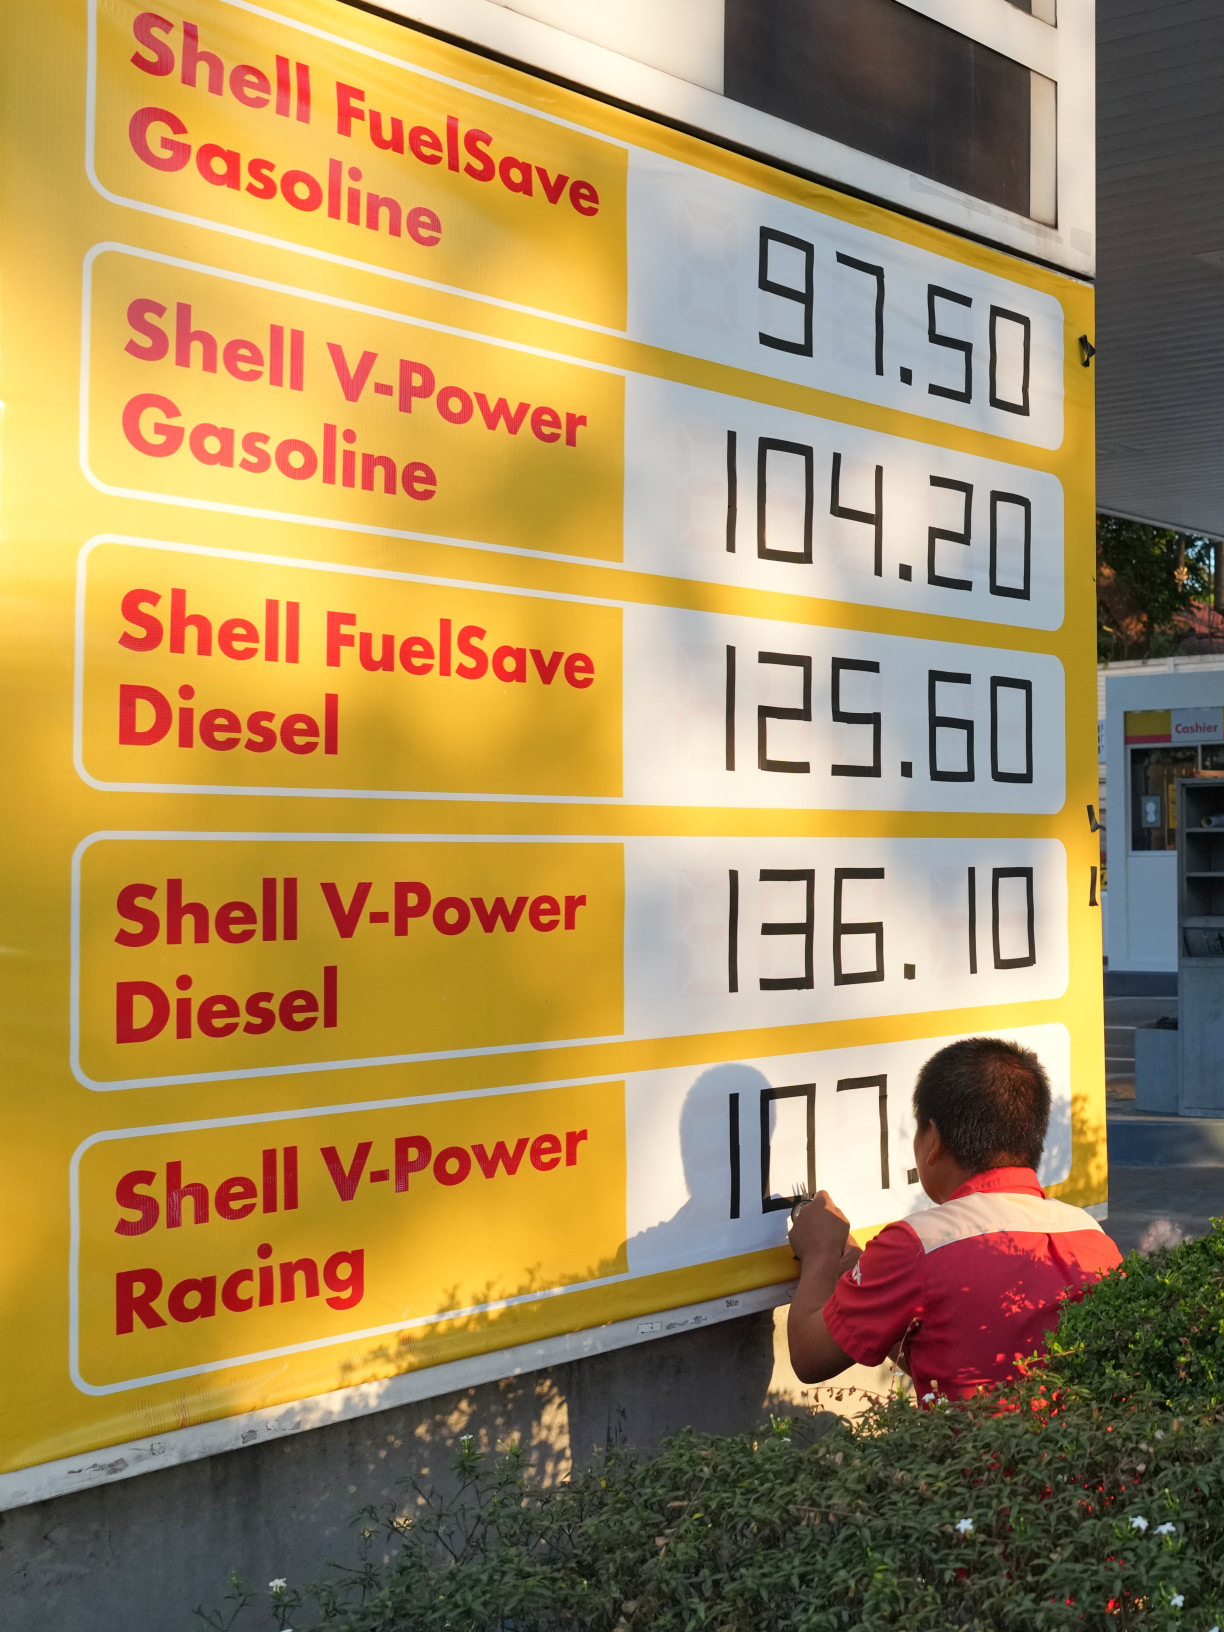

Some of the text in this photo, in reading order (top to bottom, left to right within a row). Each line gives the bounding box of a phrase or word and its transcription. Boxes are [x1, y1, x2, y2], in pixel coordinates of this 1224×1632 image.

[131, 12, 600, 217] Shell FuelSave
[128, 106, 442, 247] Gasoline
[124, 298, 588, 448] Shell V-Power
[758, 225, 1031, 417] 97.50
[121, 392, 438, 501] Gasoline
[726, 430, 1031, 601] 104.20
[118, 587, 595, 689] Shell FuelSave
[118, 684, 339, 755] Diesel
[725, 644, 1033, 783] 125.60
[1175, 722, 1219, 734] Cashier
[114, 877, 586, 947] Shell V-Power
[728, 866, 1036, 993] 136.10
[115, 965, 338, 1044] Diesel
[114, 1128, 588, 1236] Shell V-Power
[115, 1242, 365, 1335] Racing
